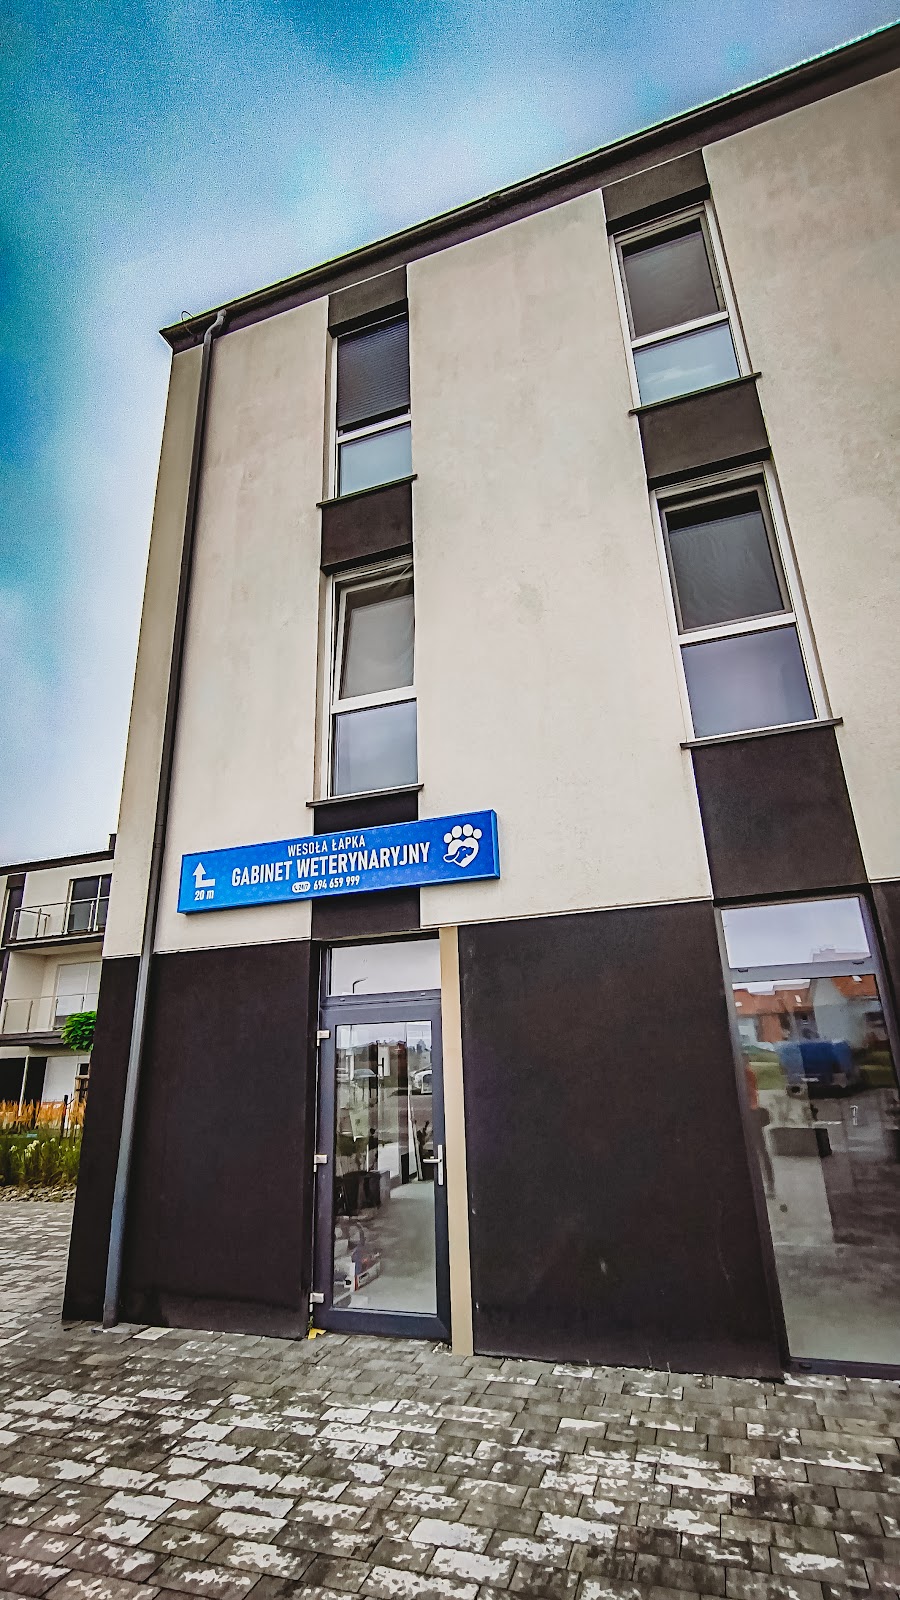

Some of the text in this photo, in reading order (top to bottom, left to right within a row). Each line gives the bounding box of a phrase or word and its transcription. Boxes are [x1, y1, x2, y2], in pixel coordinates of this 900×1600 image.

[287, 835, 366, 857] WESOŁA ŁAPKA
[231, 842, 430, 887] GABINET WETERYNARYJNY
[314, 879, 327, 890] 694
[329, 877, 344, 889] 659
[345, 875, 360, 887] 999
[194, 890, 214, 901] 20 m
